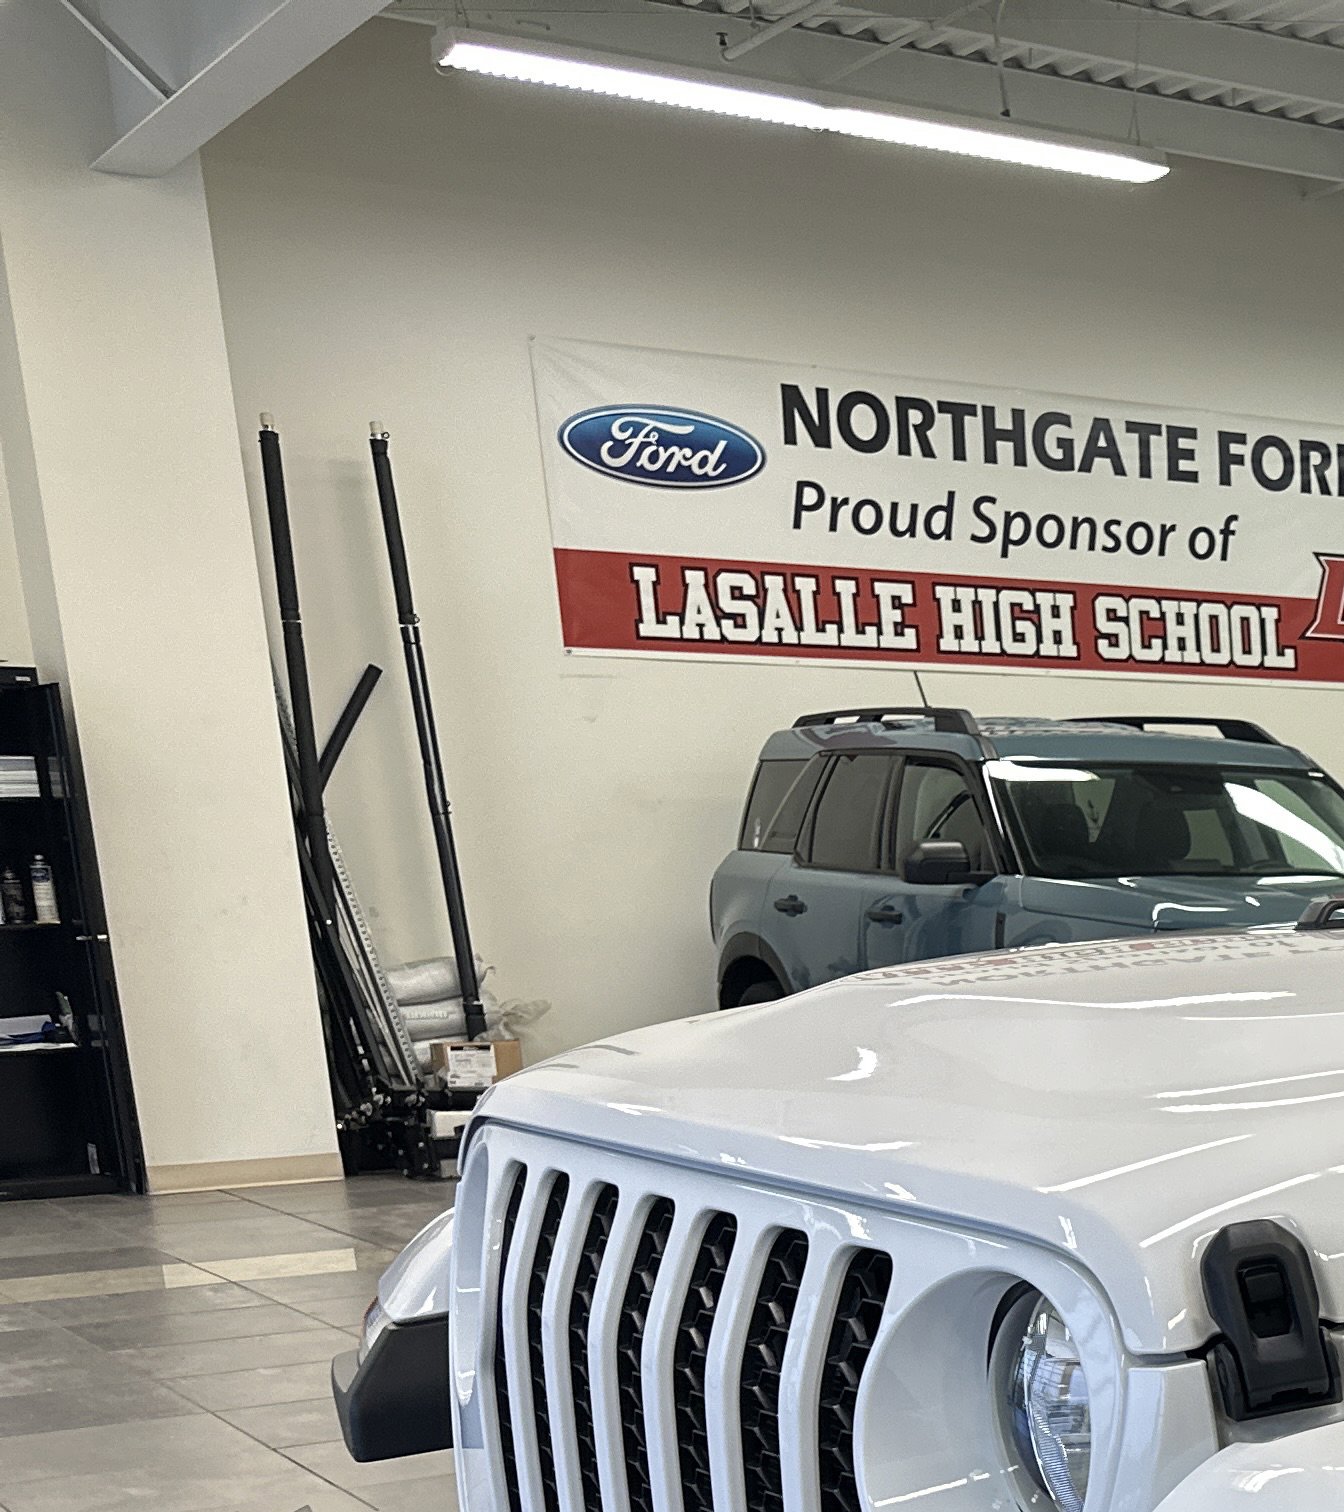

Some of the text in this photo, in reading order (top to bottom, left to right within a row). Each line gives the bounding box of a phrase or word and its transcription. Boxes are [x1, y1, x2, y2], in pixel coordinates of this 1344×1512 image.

[600, 416, 728, 477] Ford
[779, 382, 1201, 485] NORTHGATE
[791, 480, 1238, 563] Proud Sponsor of
[629, 564, 1298, 671] LASALLE HIGH SCHOOL
